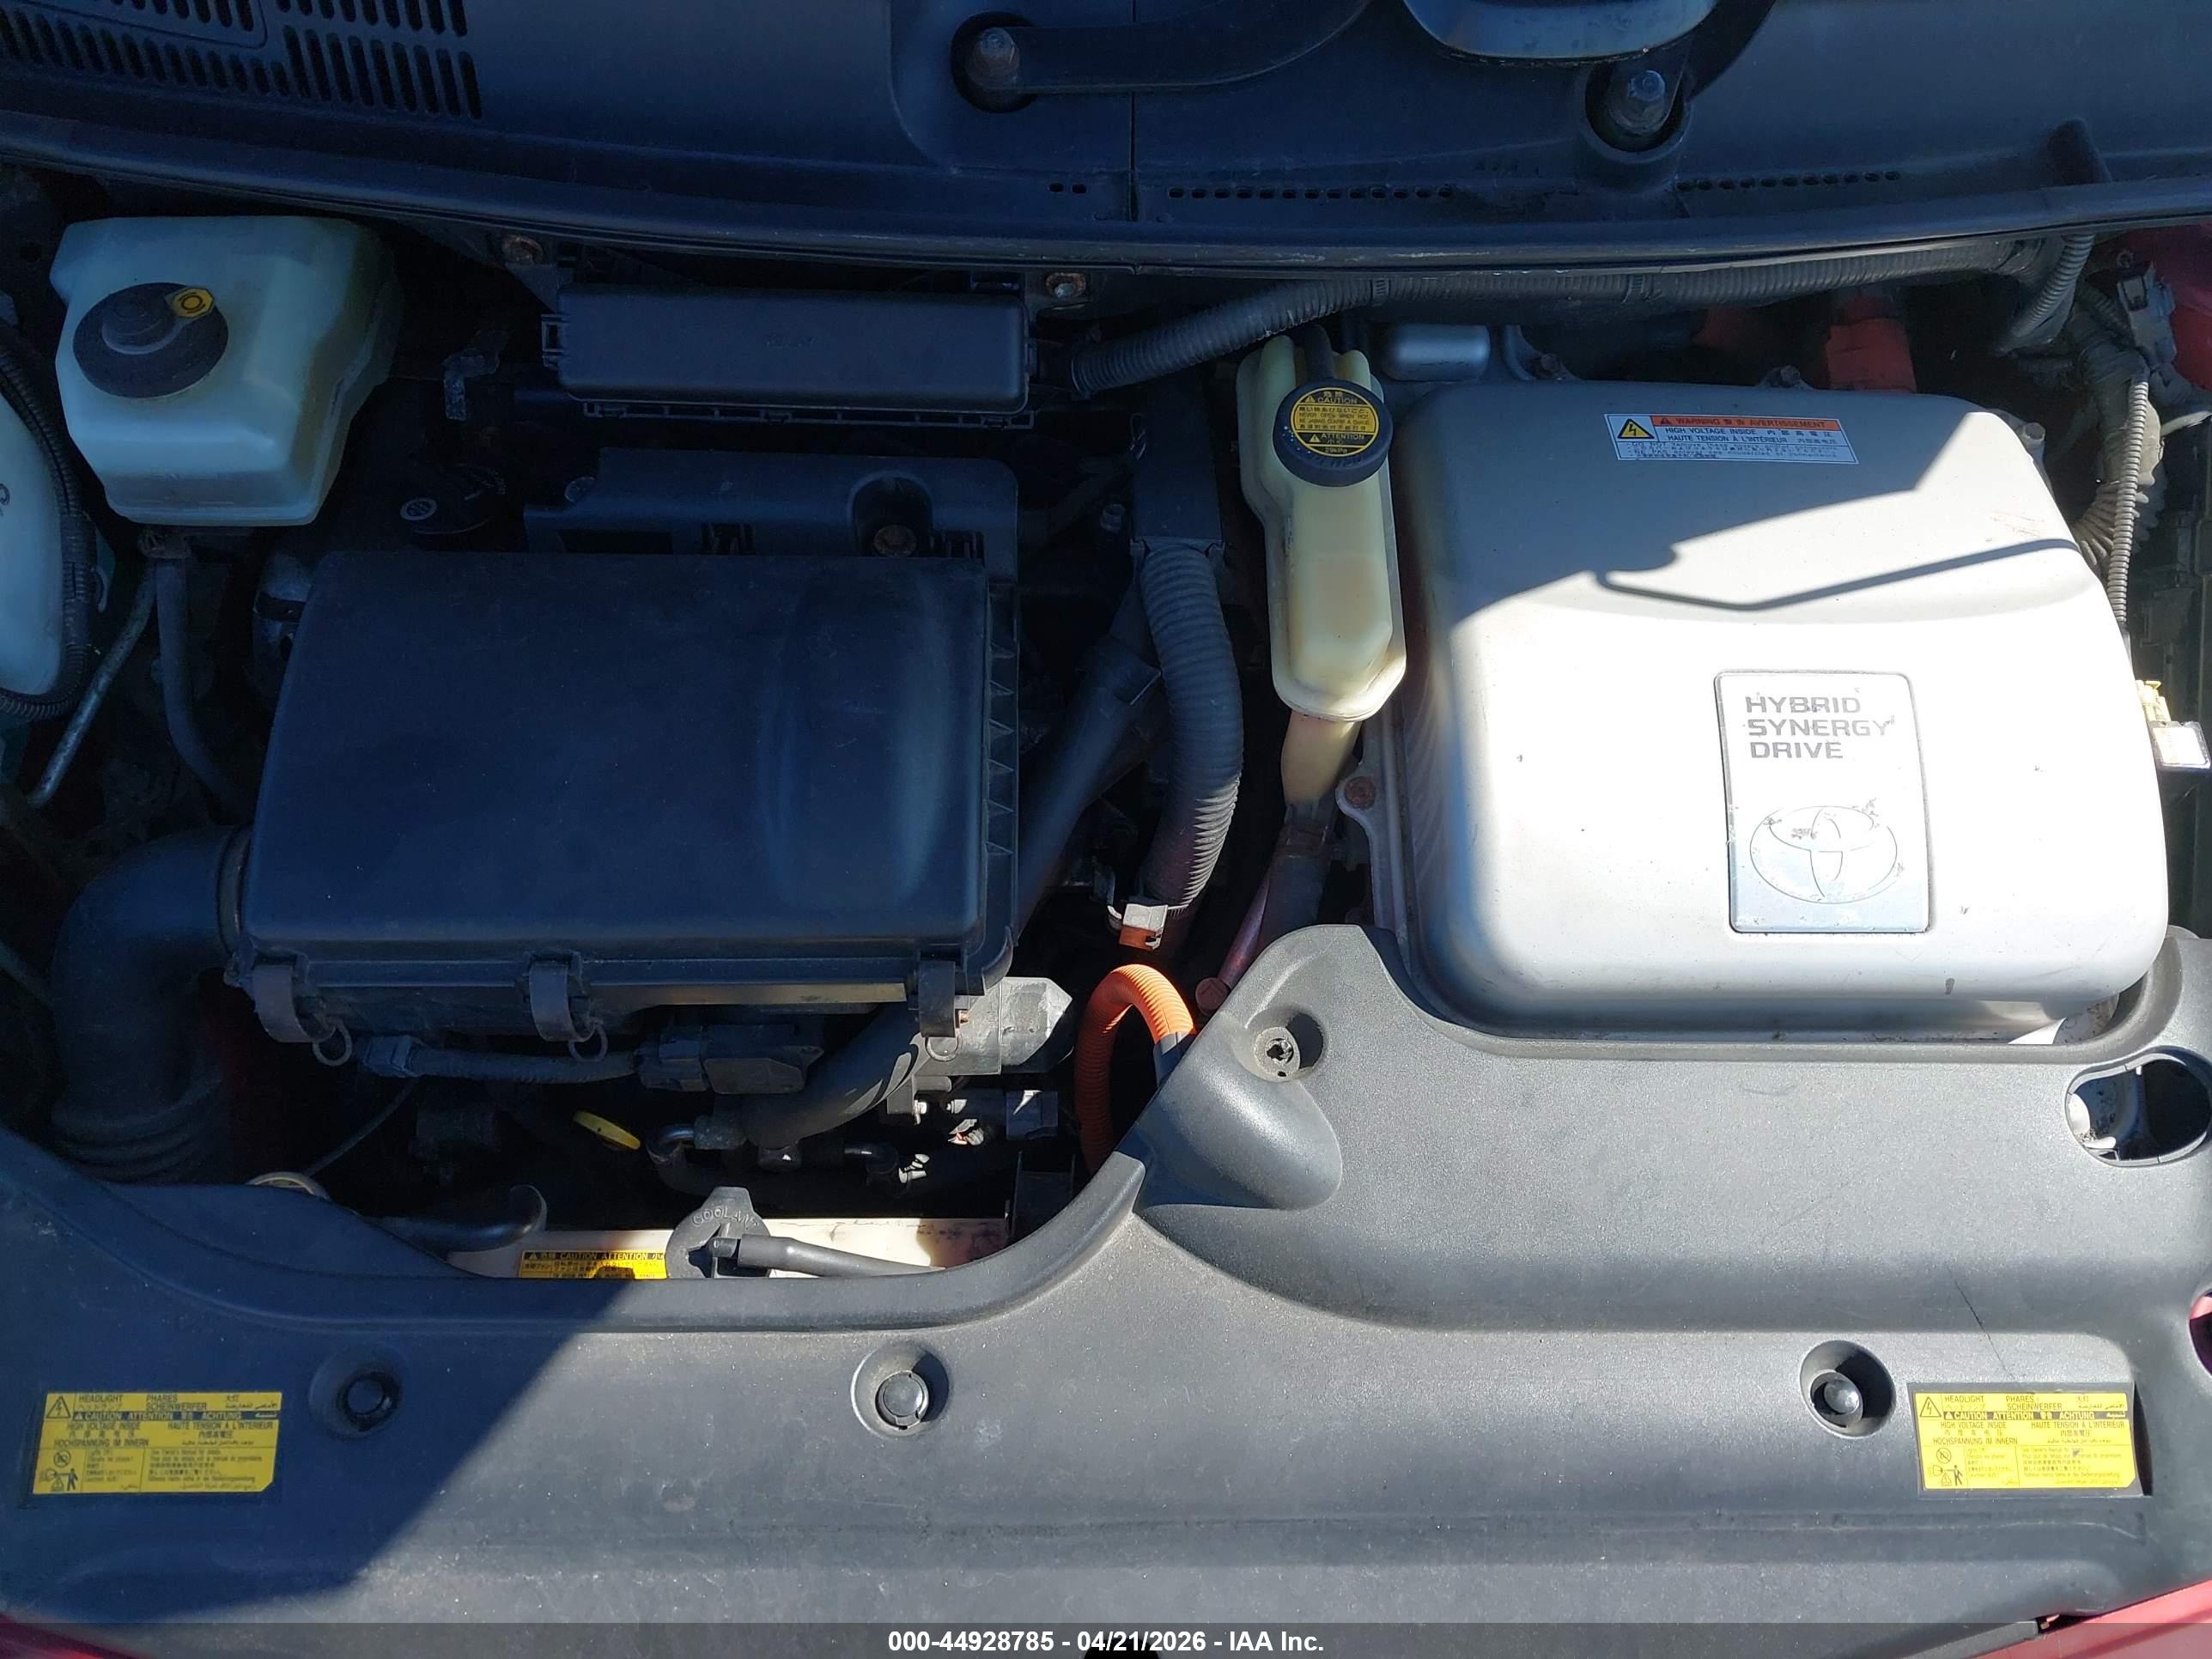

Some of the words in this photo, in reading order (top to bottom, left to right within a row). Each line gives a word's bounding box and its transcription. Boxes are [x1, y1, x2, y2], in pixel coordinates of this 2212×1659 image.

[1750, 419, 1826, 428] AVERTISSEMENT
[1745, 696, 1861, 714] HYBRID
[1747, 719, 1887, 736] SYNERGY
[1750, 742, 1843, 759] DRIVE
[602, 1252, 647, 1261] ATTENTION
[78, 1394, 123, 1402] HEADLIGHT
[146, 1394, 178, 1402] PHARES
[146, 1402, 207, 1411] SCHEINWERFER
[83, 1412, 121, 1420] CAUTION
[128, 1412, 173, 1421] ATTENTION
[202, 1411, 240, 1420] ACHTUNG
[1954, 1412, 1988, 1420] CAUTION
[1992, 1412, 2033, 1420] ATTENTION
[2059, 1411, 2095, 1419] ACHTUNG
[67, 1421, 83, 1430] HIGH
[87, 1421, 116, 1430] VOLTAGE
[119, 1421, 141, 1430] INSIDE
[167, 1421, 189, 1430] HAUTE
[193, 1421, 222, 1430] TENSION
[54, 1438, 110, 1447] HOCHSPANNUNG
